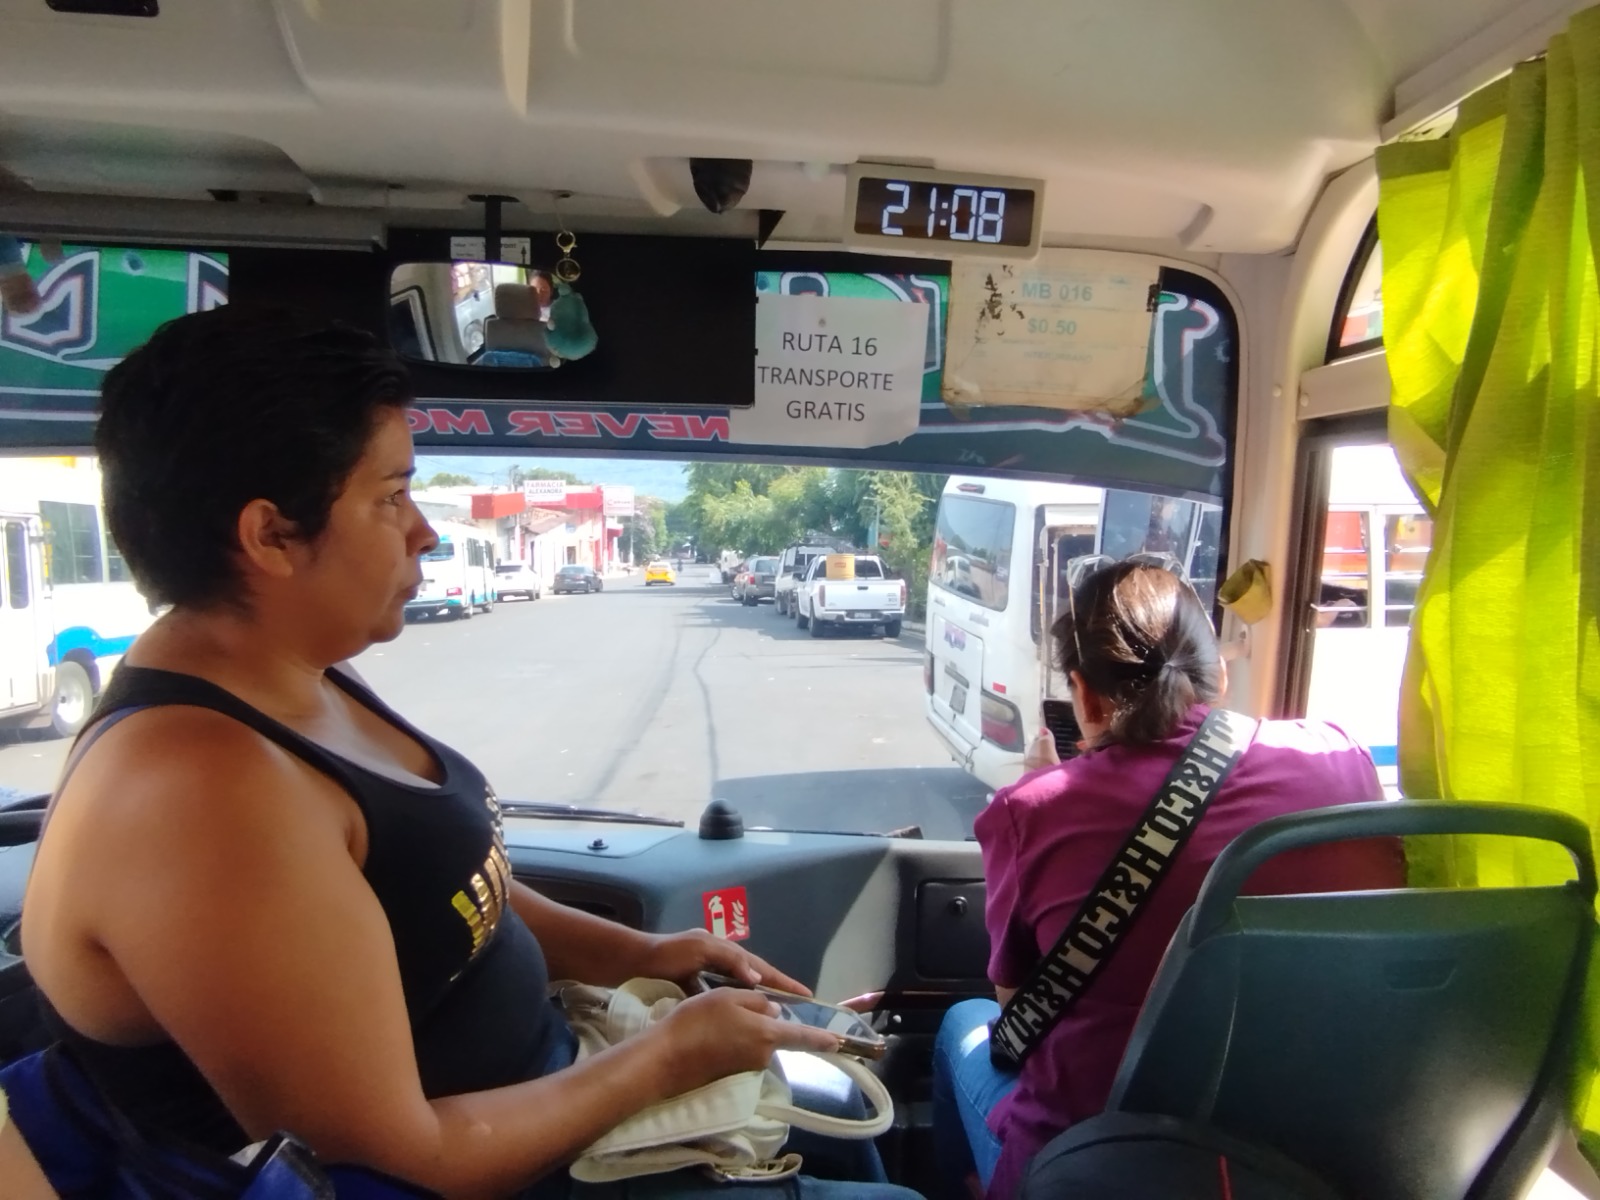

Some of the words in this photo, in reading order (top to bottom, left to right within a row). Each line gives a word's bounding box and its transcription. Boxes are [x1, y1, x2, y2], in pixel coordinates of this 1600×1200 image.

[881, 183, 1006, 243] 21:08
[1022, 282, 1052, 299] MB
[1059, 285, 1093, 302] 016
[1026, 318, 1077, 336] $0.50
[782, 331, 842, 355] RUTA
[852, 336, 877, 356] 16
[757, 365, 894, 391] TRANSPORTE
[786, 400, 866, 422] GRATIS
